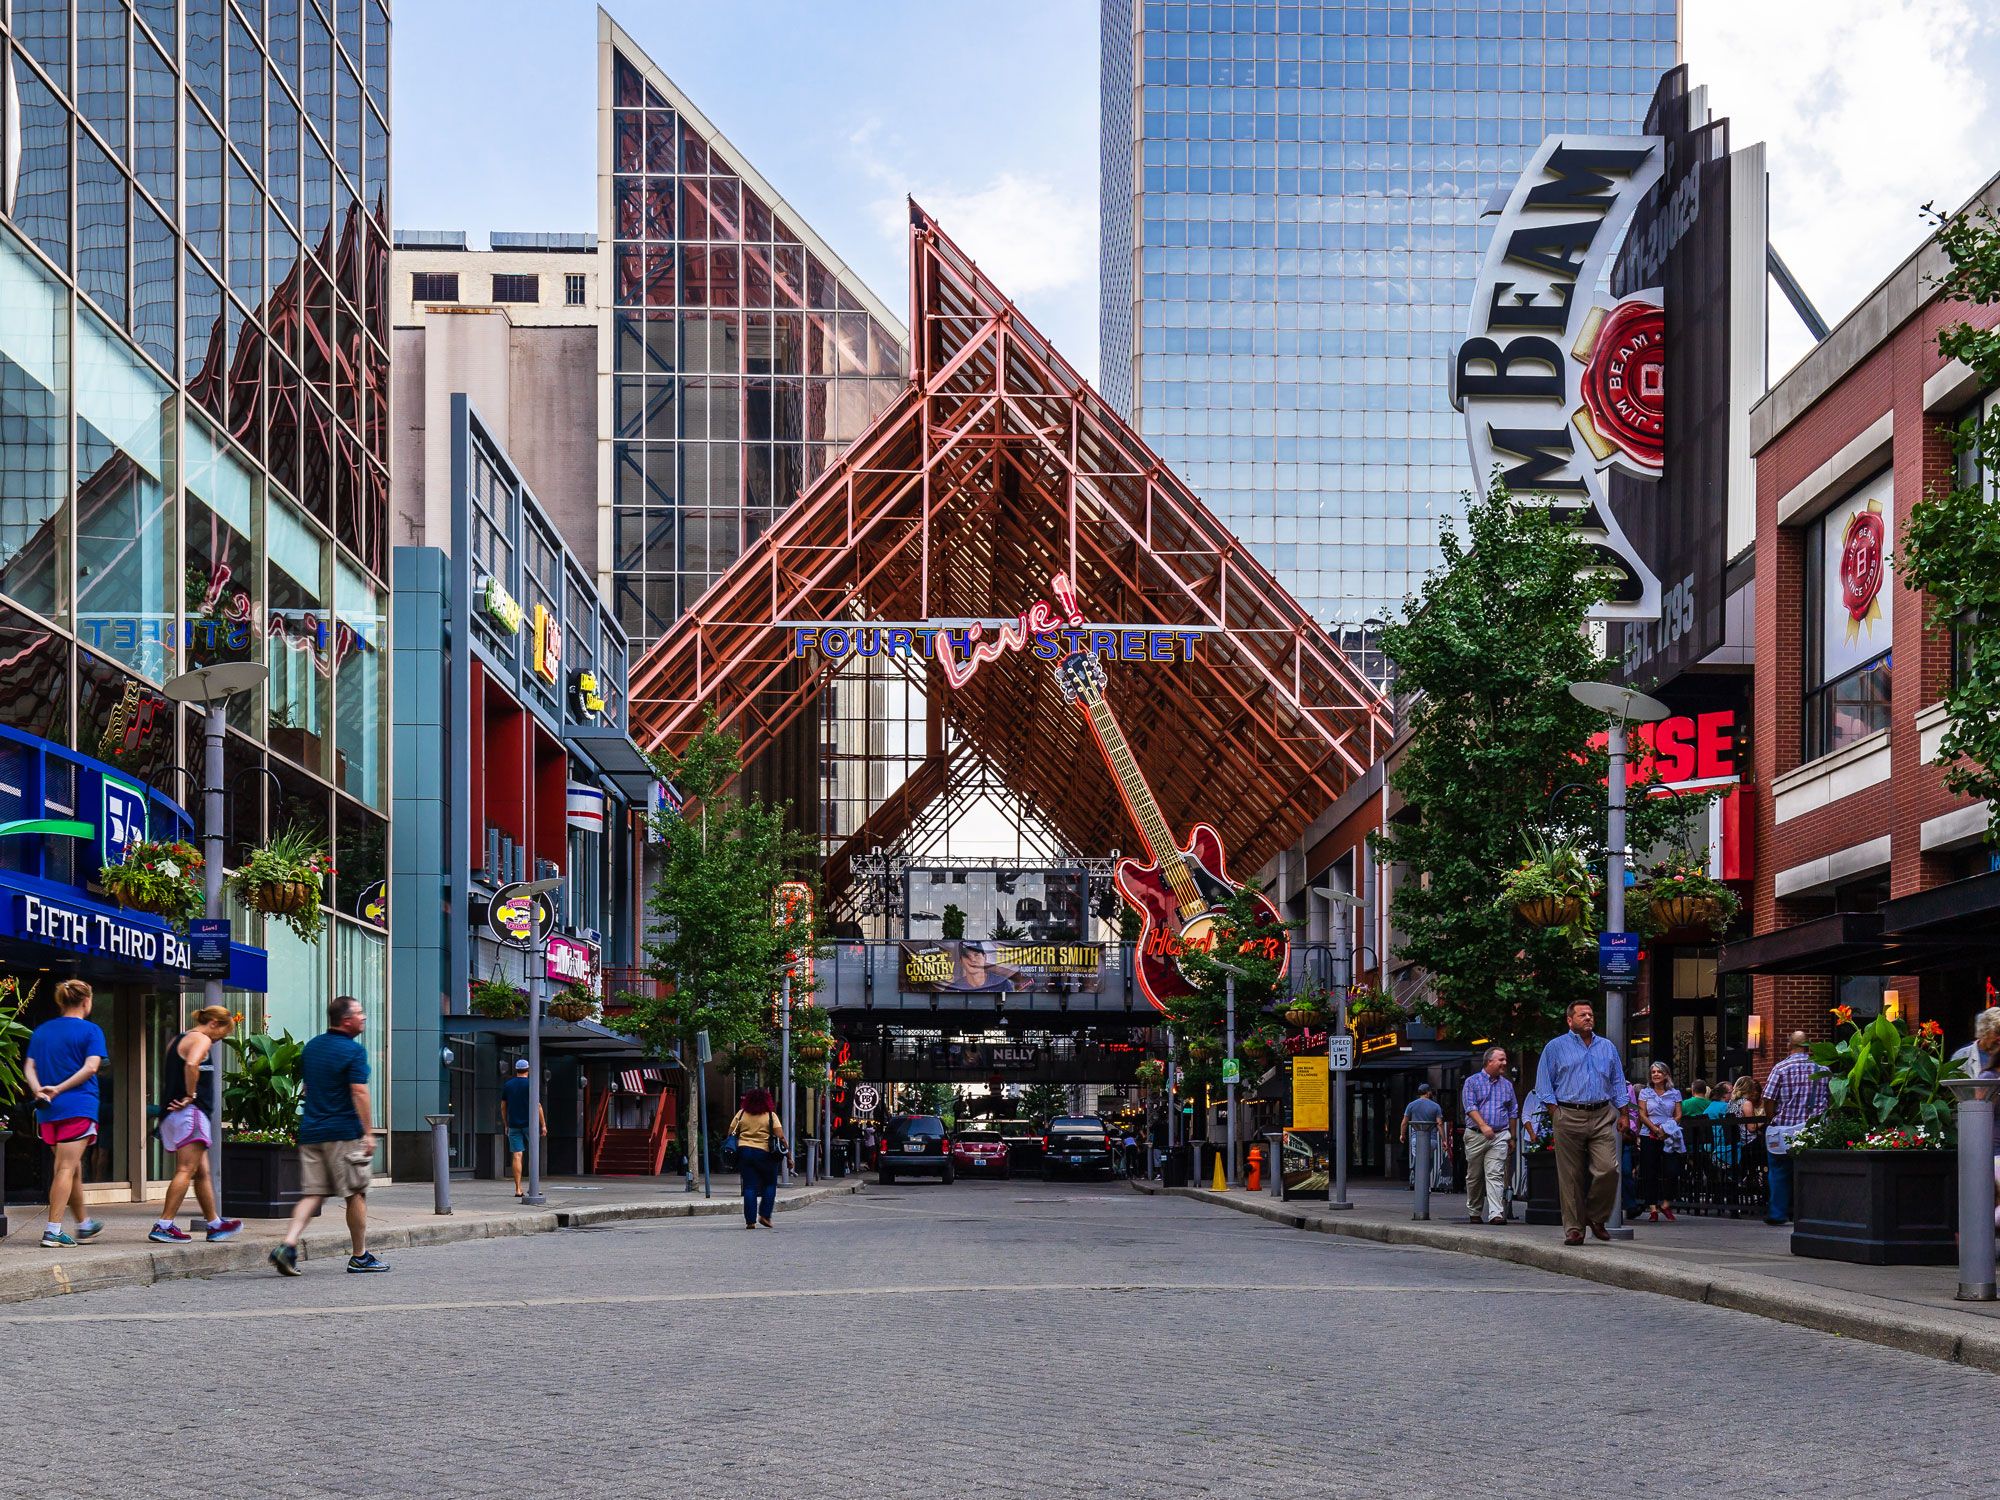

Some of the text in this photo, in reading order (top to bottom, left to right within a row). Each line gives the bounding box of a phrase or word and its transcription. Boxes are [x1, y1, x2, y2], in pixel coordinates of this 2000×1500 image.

[1456, 140, 1656, 406] BEAM
[1609, 333, 1649, 427] JIM BEAM
[1858, 527, 1877, 548] BEAM
[935, 569, 1084, 690] Live!
[795, 627, 1202, 662] FOURTH STREET
[25, 895, 87, 945] FIFTH
[96, 915, 157, 961] THIRD
[163, 932, 190, 969] BA
[910, 953, 949, 963] HOT
[996, 947, 1099, 966] GRANGER SMITH
[906, 961, 955, 976] COUNTRY
[993, 1048, 1035, 1060] NELLY
[1333, 1053, 1348, 1067] 15
